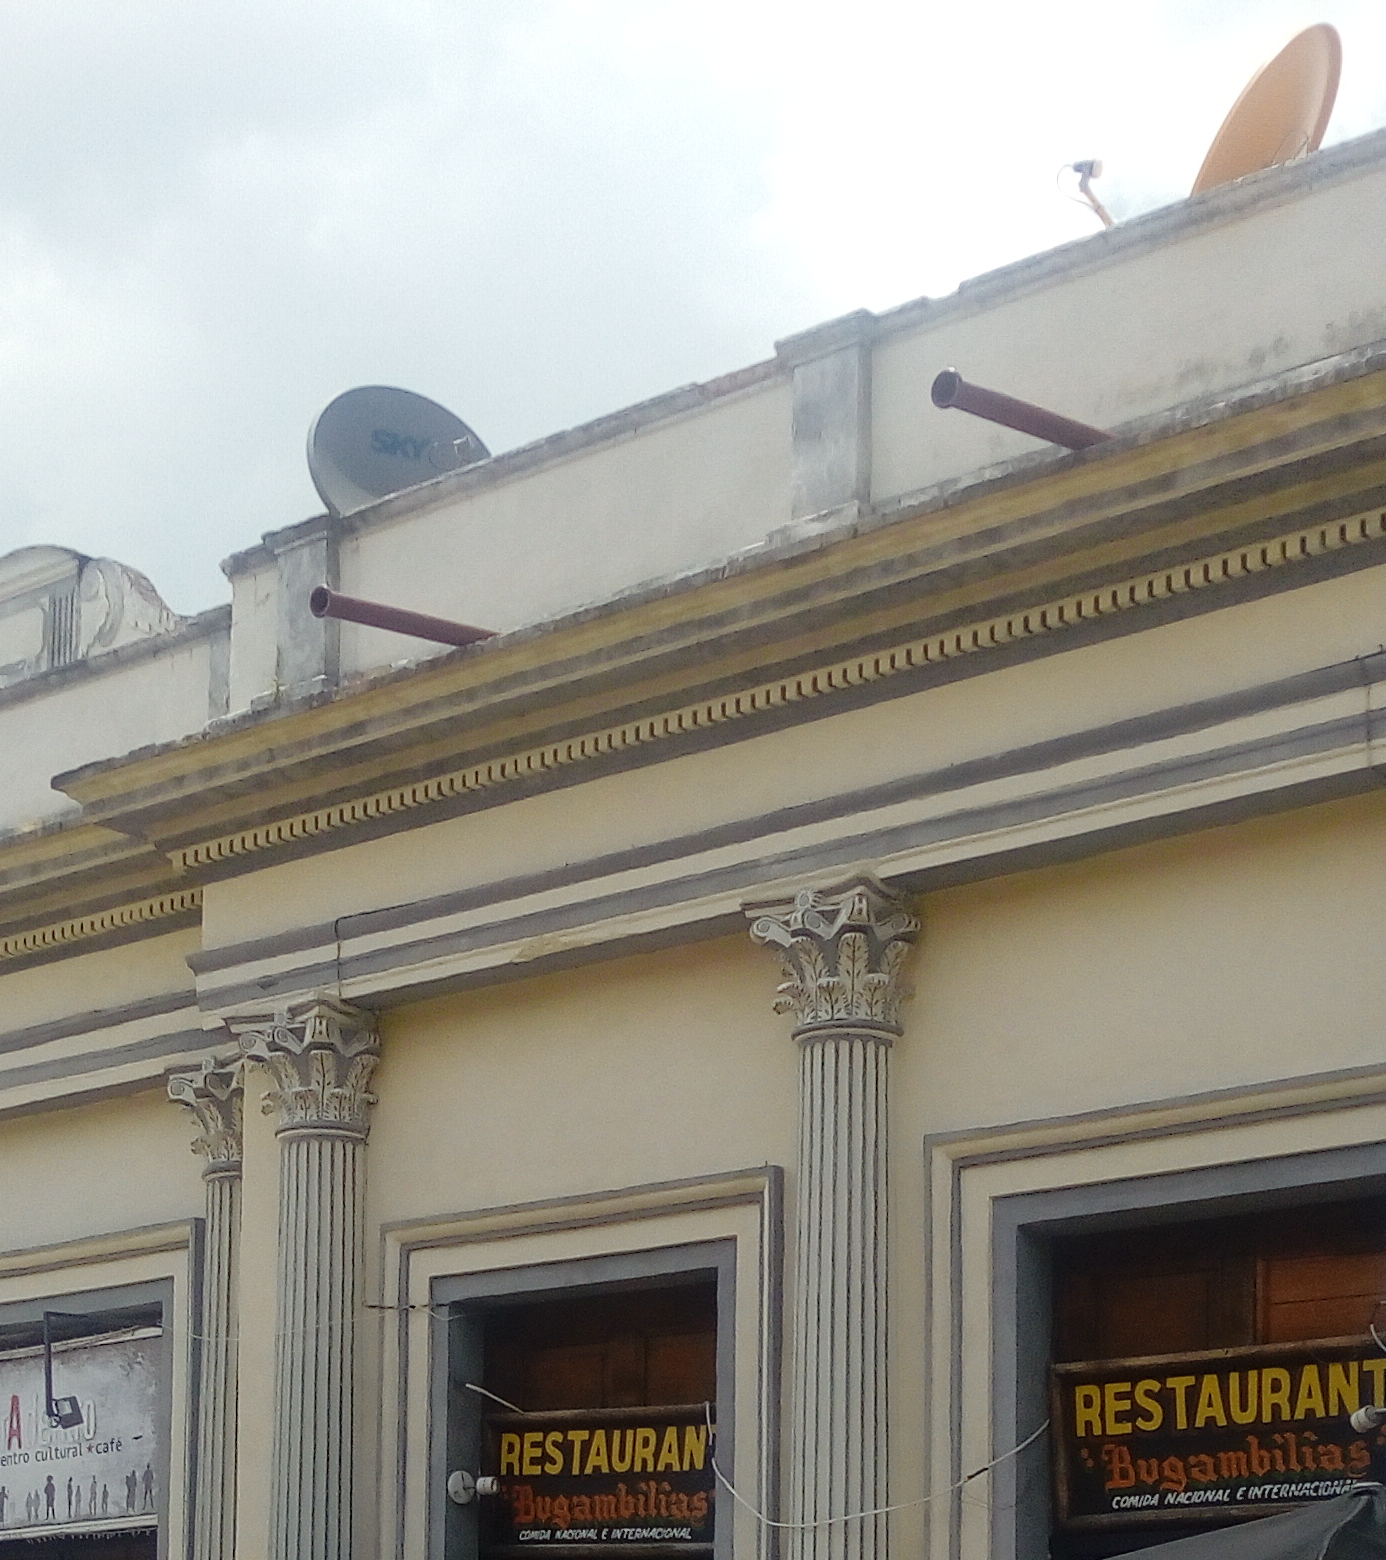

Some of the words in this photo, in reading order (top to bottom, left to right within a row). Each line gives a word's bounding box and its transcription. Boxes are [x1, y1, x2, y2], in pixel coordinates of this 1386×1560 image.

[35, 1444, 83, 1462] cultural
[95, 1437, 123, 1454] café
[500, 1424, 716, 1476] RESTAURAN
[1104, 1432, 1372, 1492] Bugambilias
[1112, 1493, 1159, 1510] COMIDA
[1164, 1489, 1230, 1506] NACIONAL
[1236, 1486, 1246, 1500] E
[519, 1530, 551, 1541] COMIDA
[555, 1528, 598, 1540] NACIONAL
[601, 1528, 609, 1540] E
[611, 1527, 692, 1540] INTERNACIONAL
